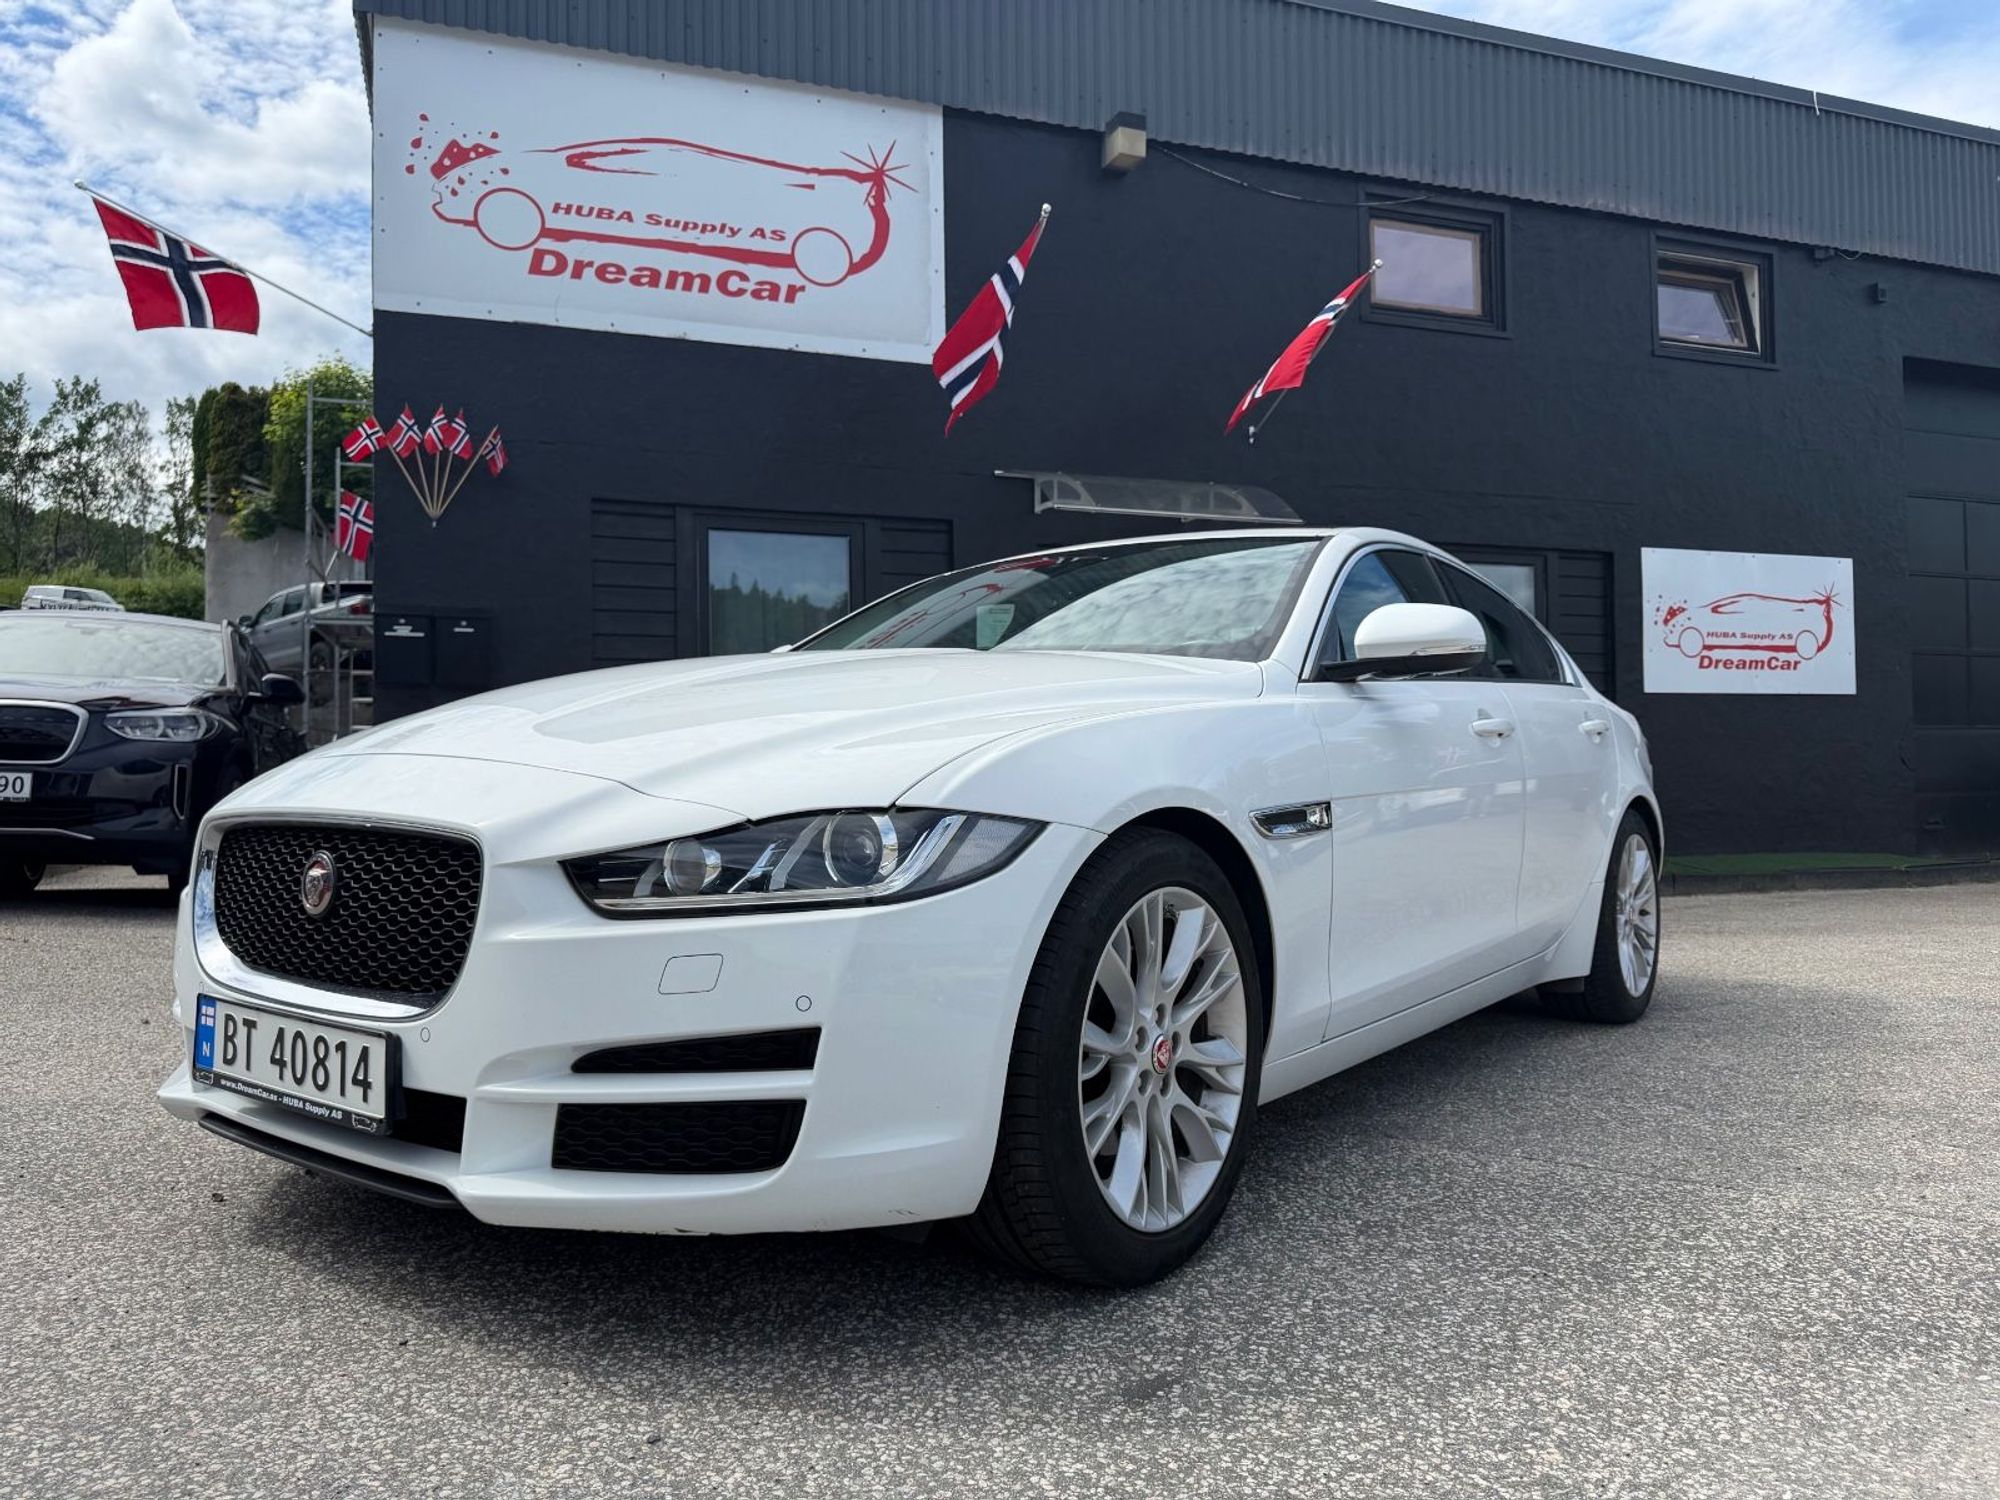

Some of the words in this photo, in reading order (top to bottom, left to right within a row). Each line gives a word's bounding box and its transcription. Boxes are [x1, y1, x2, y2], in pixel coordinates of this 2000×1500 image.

[552, 202, 634, 223] HUBA
[645, 213, 742, 238] Supply
[749, 226, 787, 243] AS
[529, 249, 805, 304] DreamCar
[1706, 631, 1737, 639] HUBA
[1740, 632, 1777, 641] Supply
[1698, 655, 1801, 671] DreamCar
[202, 1040, 211, 1057] N
[222, 1013, 257, 1071] BT
[270, 1026, 372, 1104] 40814
[283, 1096, 304, 1109] HUBA
[304, 1102, 331, 1118] Supply
[330, 1110, 343, 1120] AS
